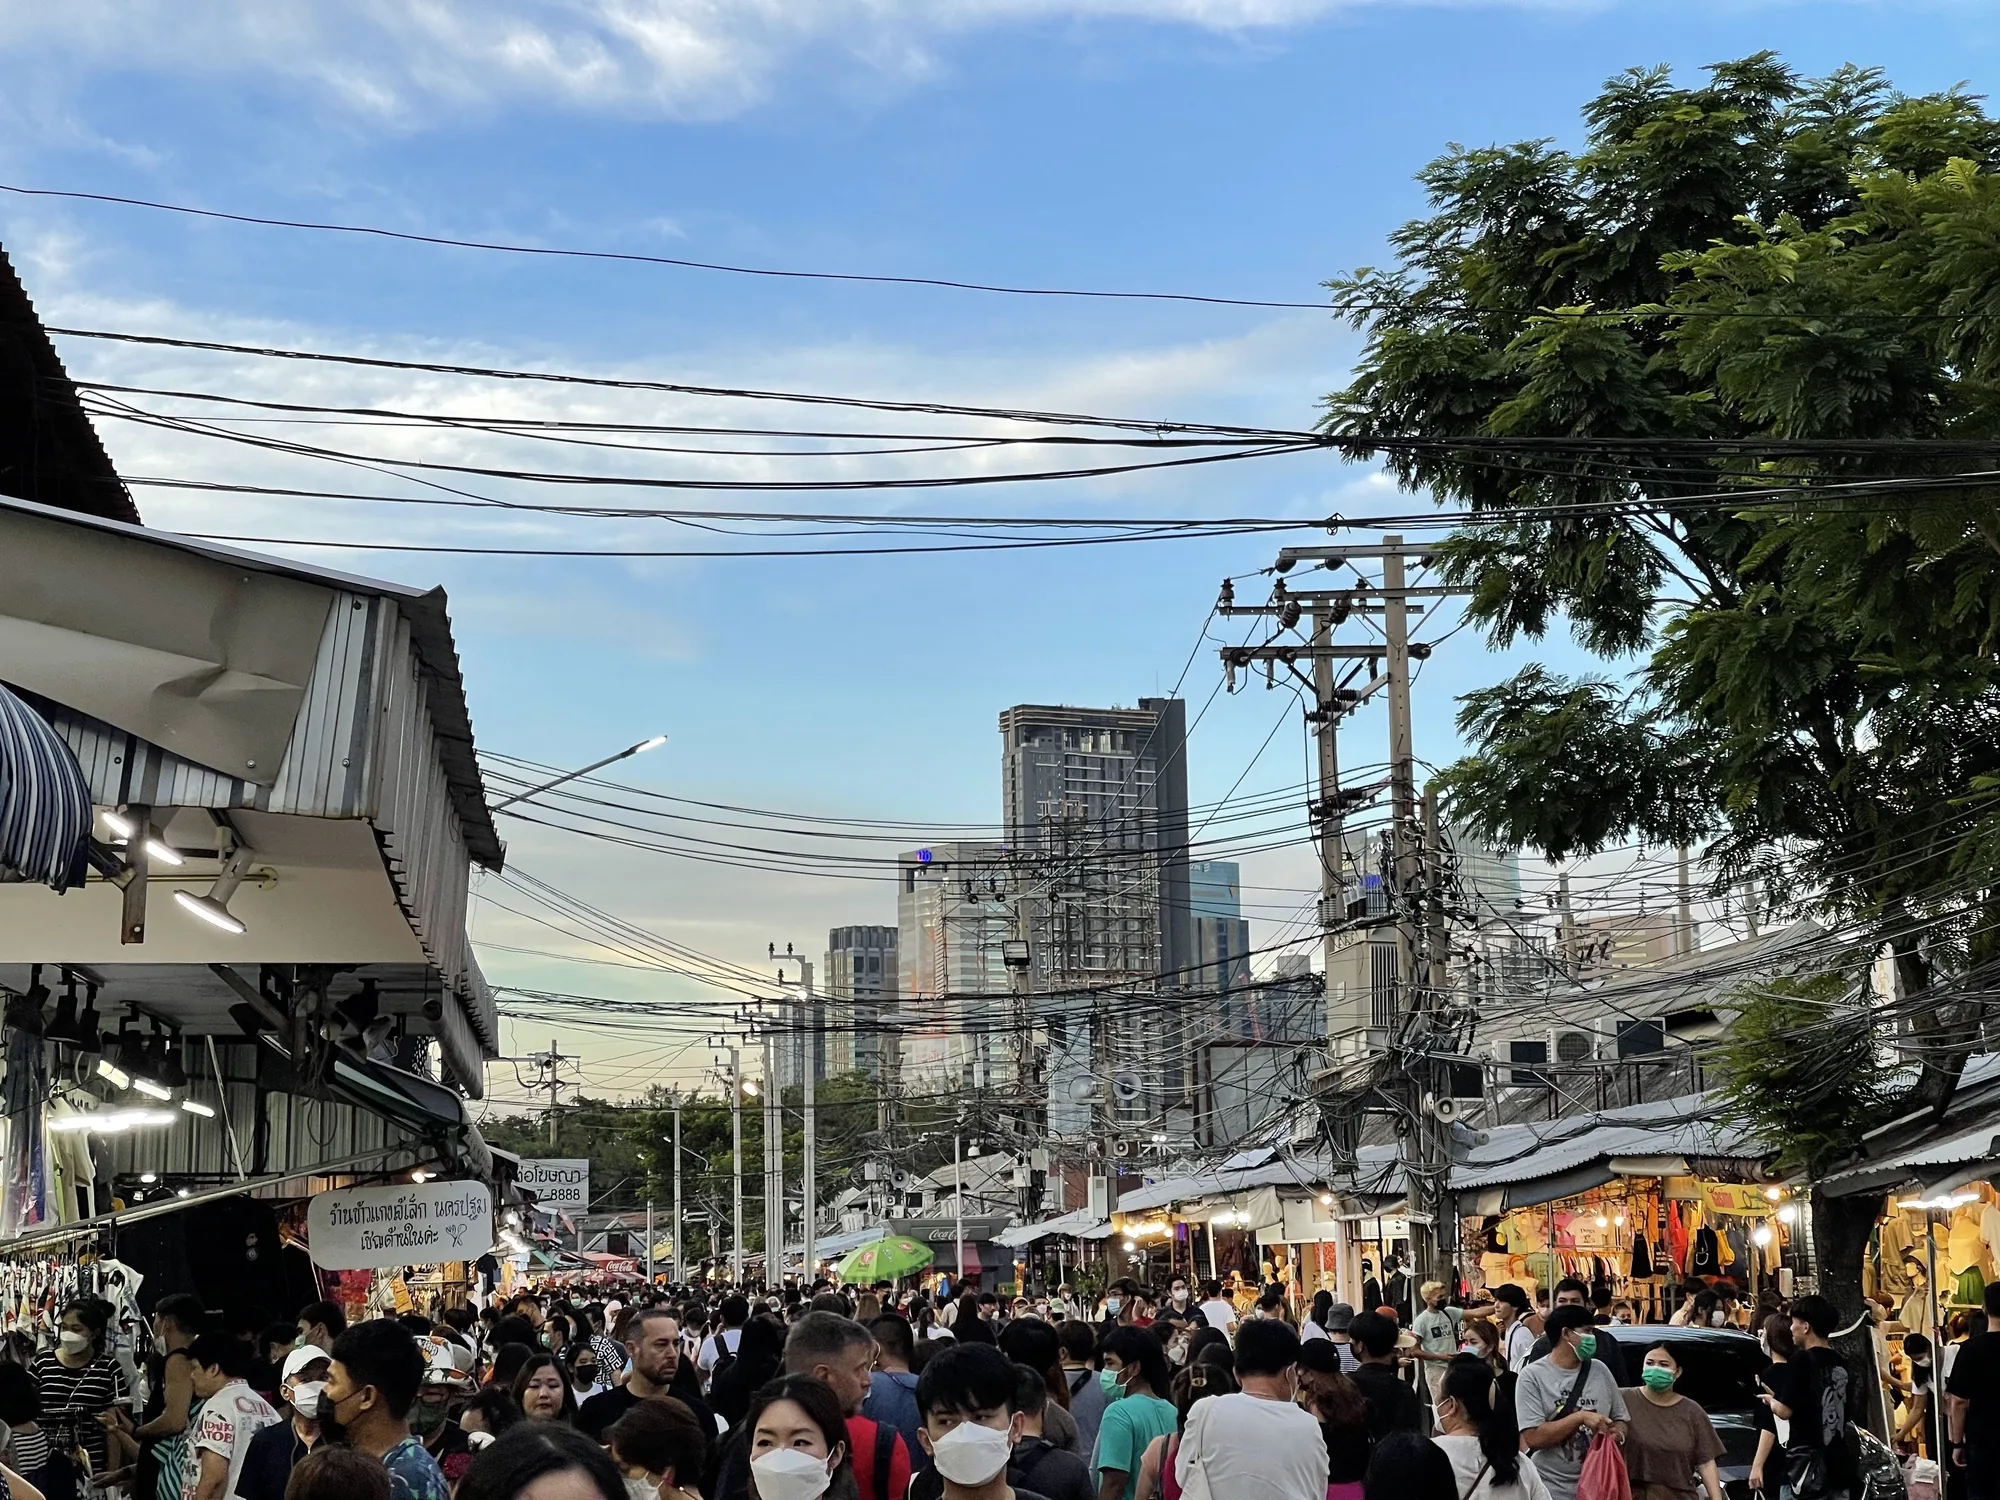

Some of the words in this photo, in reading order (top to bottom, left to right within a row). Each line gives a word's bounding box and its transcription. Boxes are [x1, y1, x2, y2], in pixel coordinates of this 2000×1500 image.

[434, 1192, 487, 1221] นครปฐม
[360, 1222, 440, 1251] เชิญด้านในค่ะ
